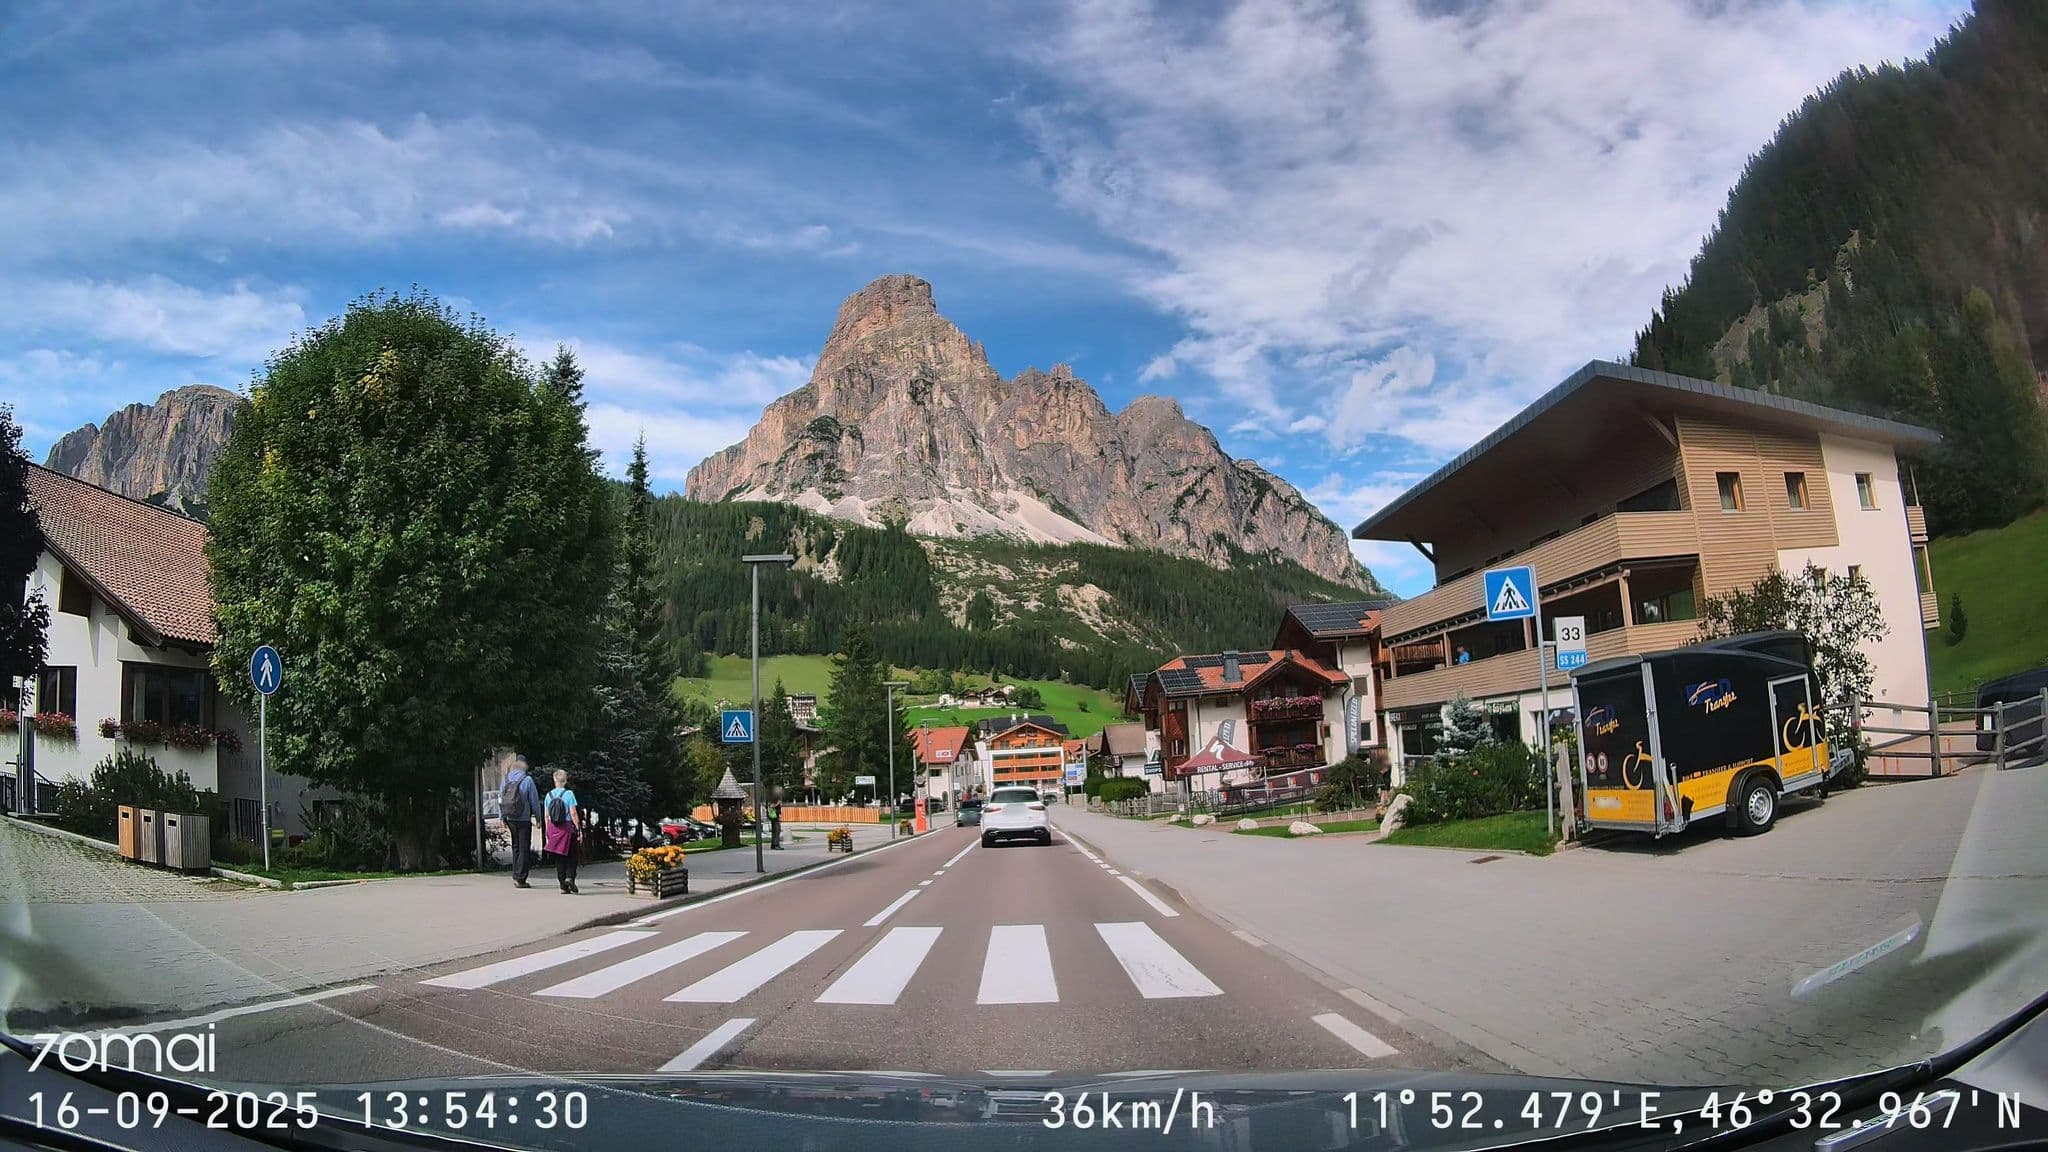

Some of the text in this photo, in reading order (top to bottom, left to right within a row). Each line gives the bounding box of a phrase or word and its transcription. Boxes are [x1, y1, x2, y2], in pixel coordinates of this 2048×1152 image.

[1561, 626, 1581, 641] 33
[1559, 653, 1585, 666] SS 244
[1196, 763, 1218, 773] RENTAL
[1221, 760, 1245, 771] SERVICE
